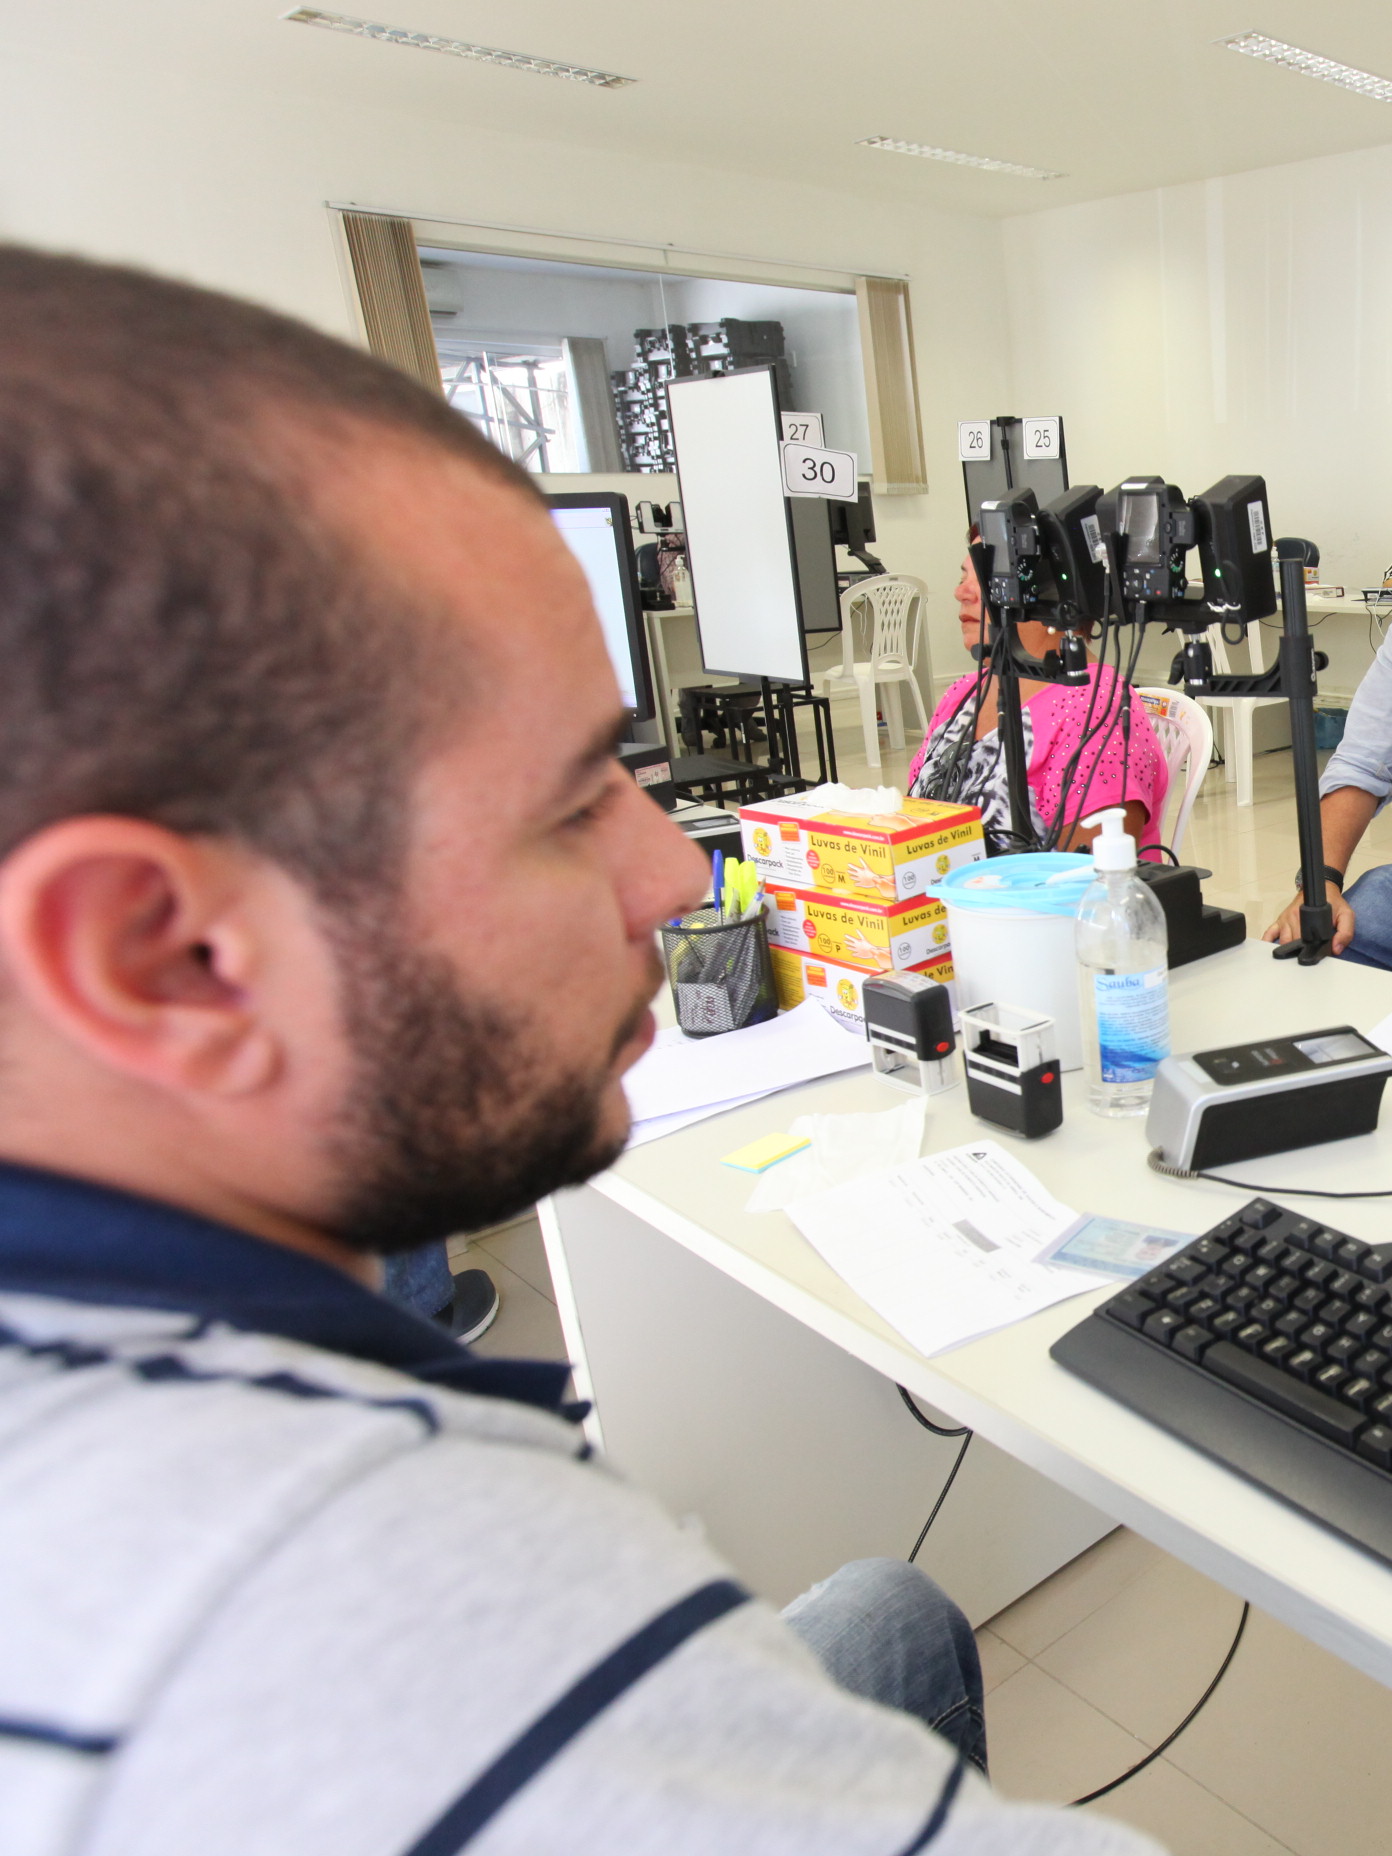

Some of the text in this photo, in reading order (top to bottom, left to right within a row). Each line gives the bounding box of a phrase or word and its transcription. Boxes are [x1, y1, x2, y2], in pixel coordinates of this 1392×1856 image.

[788, 423, 809, 441] 27
[967, 430, 984, 449] 26
[1034, 429, 1051, 448] 25
[800, 457, 836, 484] 30
[810, 834, 887, 860] Luvas de Vinil
[906, 825, 973, 855] Luvas de Vinil
[747, 854, 784, 869] Descarpack
[837, 874, 846, 884] M
[807, 905, 885, 931] Luvas de Vinil
[903, 903, 947, 926] Luvas de
[836, 945, 842, 953] P
[937, 964, 954, 977] Vin
